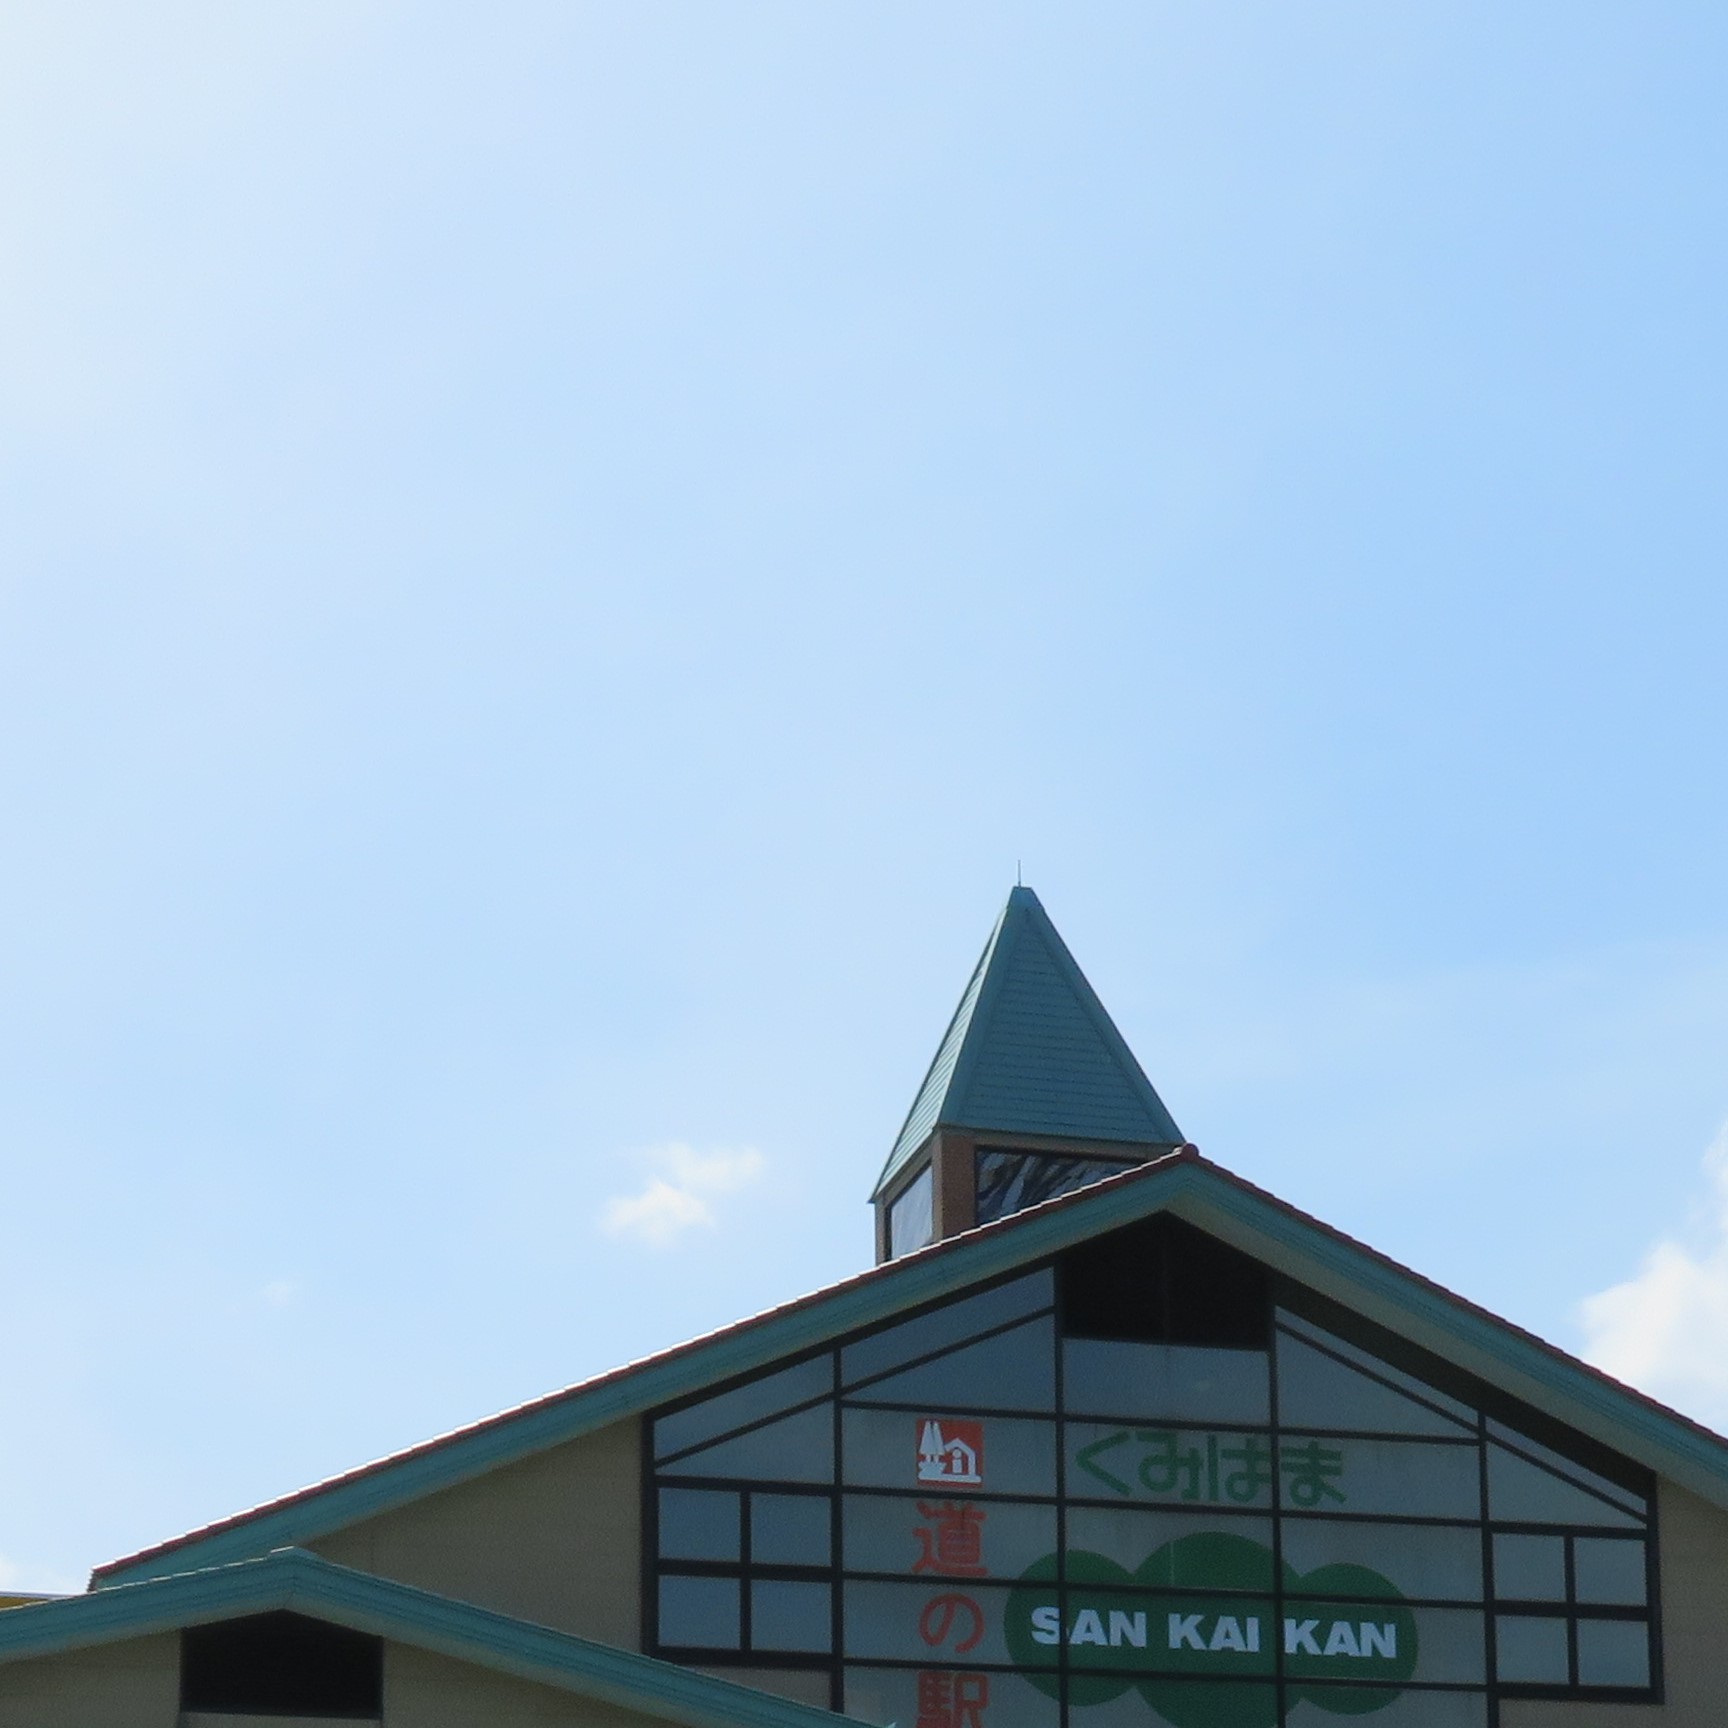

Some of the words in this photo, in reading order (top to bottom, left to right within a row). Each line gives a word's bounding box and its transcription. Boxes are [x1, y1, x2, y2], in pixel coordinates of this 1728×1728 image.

[1074, 1430, 1347, 1507] くみはま
[1030, 1606, 1147, 1648] SAN
[1168, 1613, 1260, 1653] KAI
[1283, 1618, 1397, 1659] KAN
